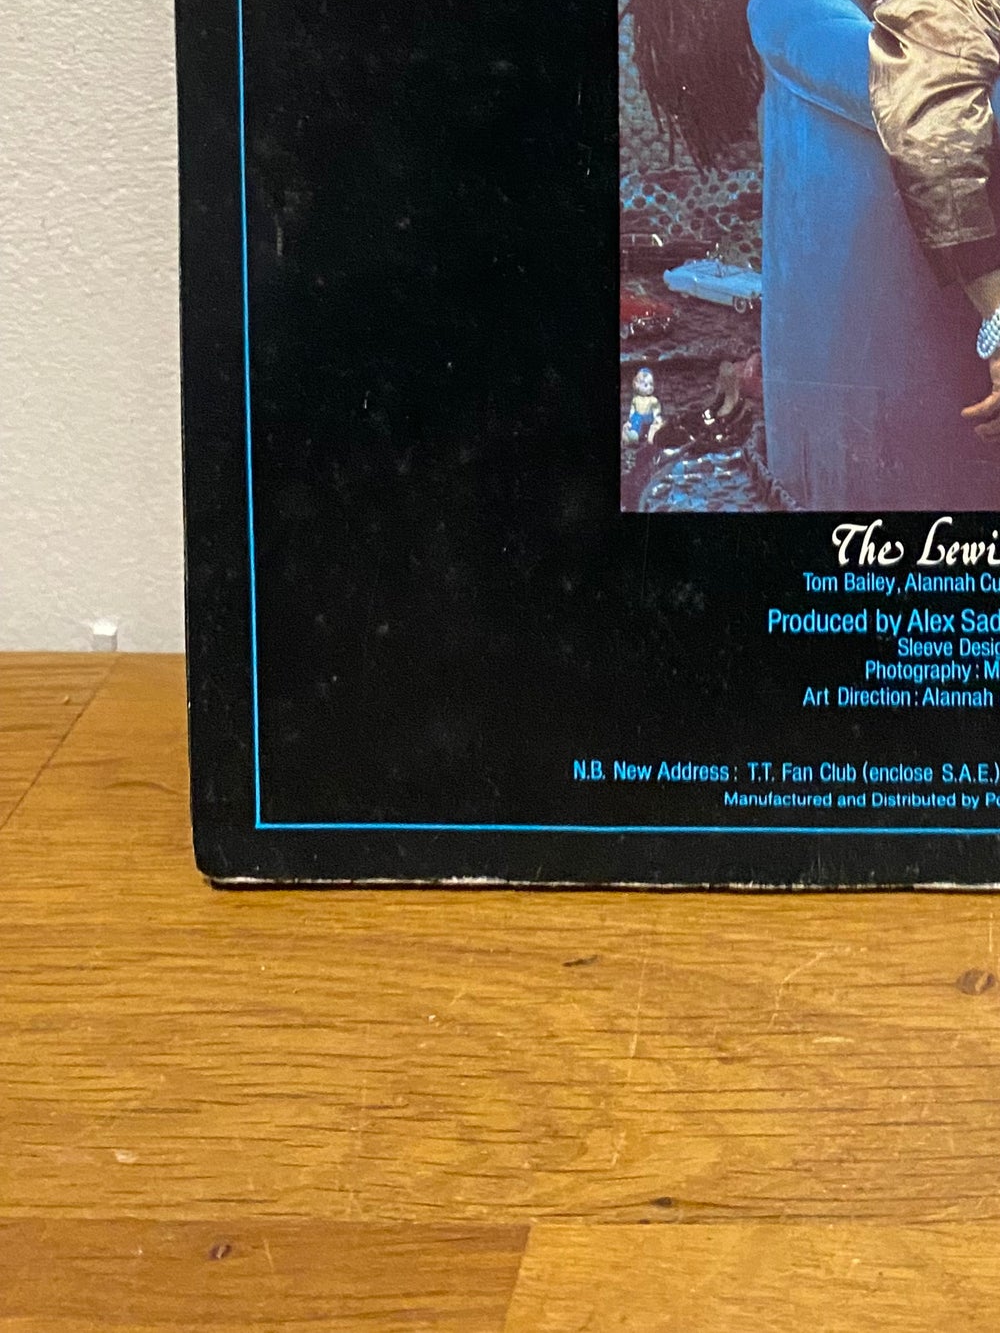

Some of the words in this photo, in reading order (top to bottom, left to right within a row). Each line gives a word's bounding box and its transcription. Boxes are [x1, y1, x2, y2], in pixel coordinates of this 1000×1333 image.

[831, 518, 905, 567] The
[802, 571, 838, 593] Tom
[843, 571, 901, 597] Bailey,
[904, 572, 976, 593] Alannah
[767, 608, 868, 634] Produced
[875, 608, 902, 636] by
[907, 608, 956, 634] Alex
[897, 636, 955, 658] Sleeve
[802, 686, 830, 707] Art
[921, 686, 994, 708] Alannah
[573, 759, 606, 781] N.B.
[613, 760, 653, 782] New
[747, 761, 776, 782] T.T.
[781, 762, 813, 783] Fan
[819, 761, 857, 783] Club
[862, 760, 934, 784] (enclose
[941, 761, 1000, 785] S.A.E.)
[723, 790, 833, 808] Manufactured
[837, 792, 867, 808] and
[871, 791, 957, 809] Distributed
[961, 792, 980, 811] by
